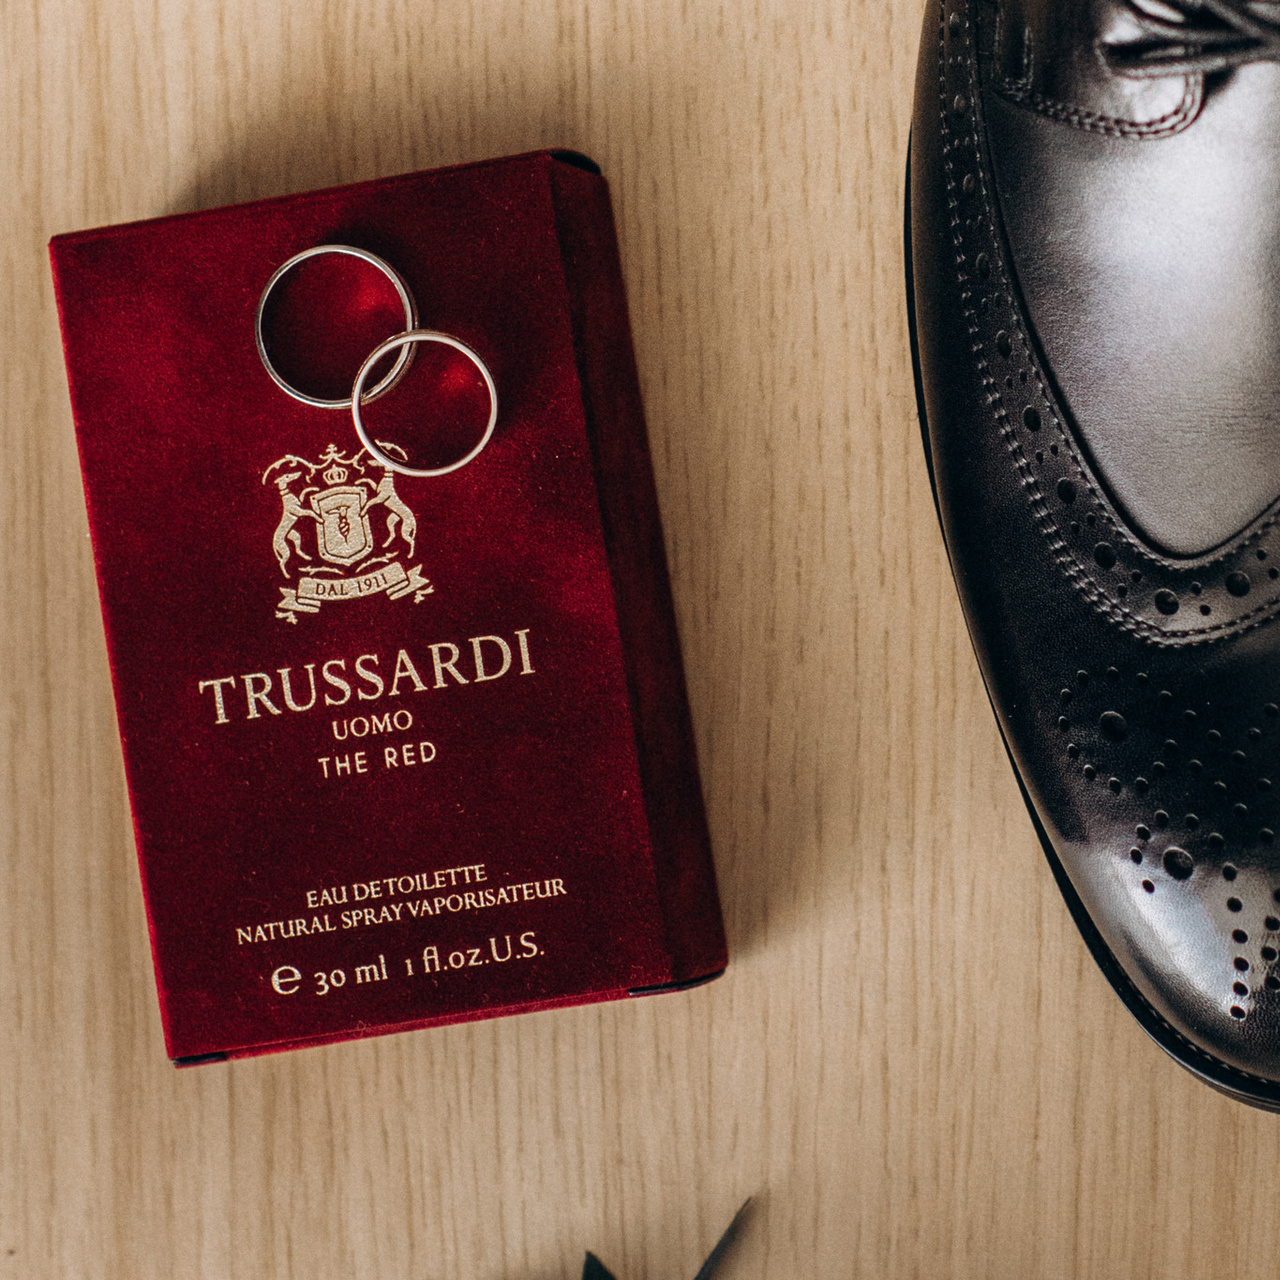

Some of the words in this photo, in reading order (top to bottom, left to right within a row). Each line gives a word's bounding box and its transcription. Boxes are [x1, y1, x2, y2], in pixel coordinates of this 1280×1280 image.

[315, 580, 349, 598] DAL
[356, 573, 389, 593] 1911
[198, 628, 536, 724] TRUSSARDI
[331, 709, 413, 740] UOMO
[318, 751, 368, 779] THE
[384, 741, 437, 767] RED
[306, 886, 348, 908] EAU
[353, 881, 381, 902] DE
[383, 864, 488, 897] TOILETTE
[236, 914, 337, 945] NATURAL
[341, 902, 404, 930] SPRAY
[405, 878, 567, 918] VAPORISATEUR
[313, 969, 346, 996] 30
[355, 954, 388, 984] ml
